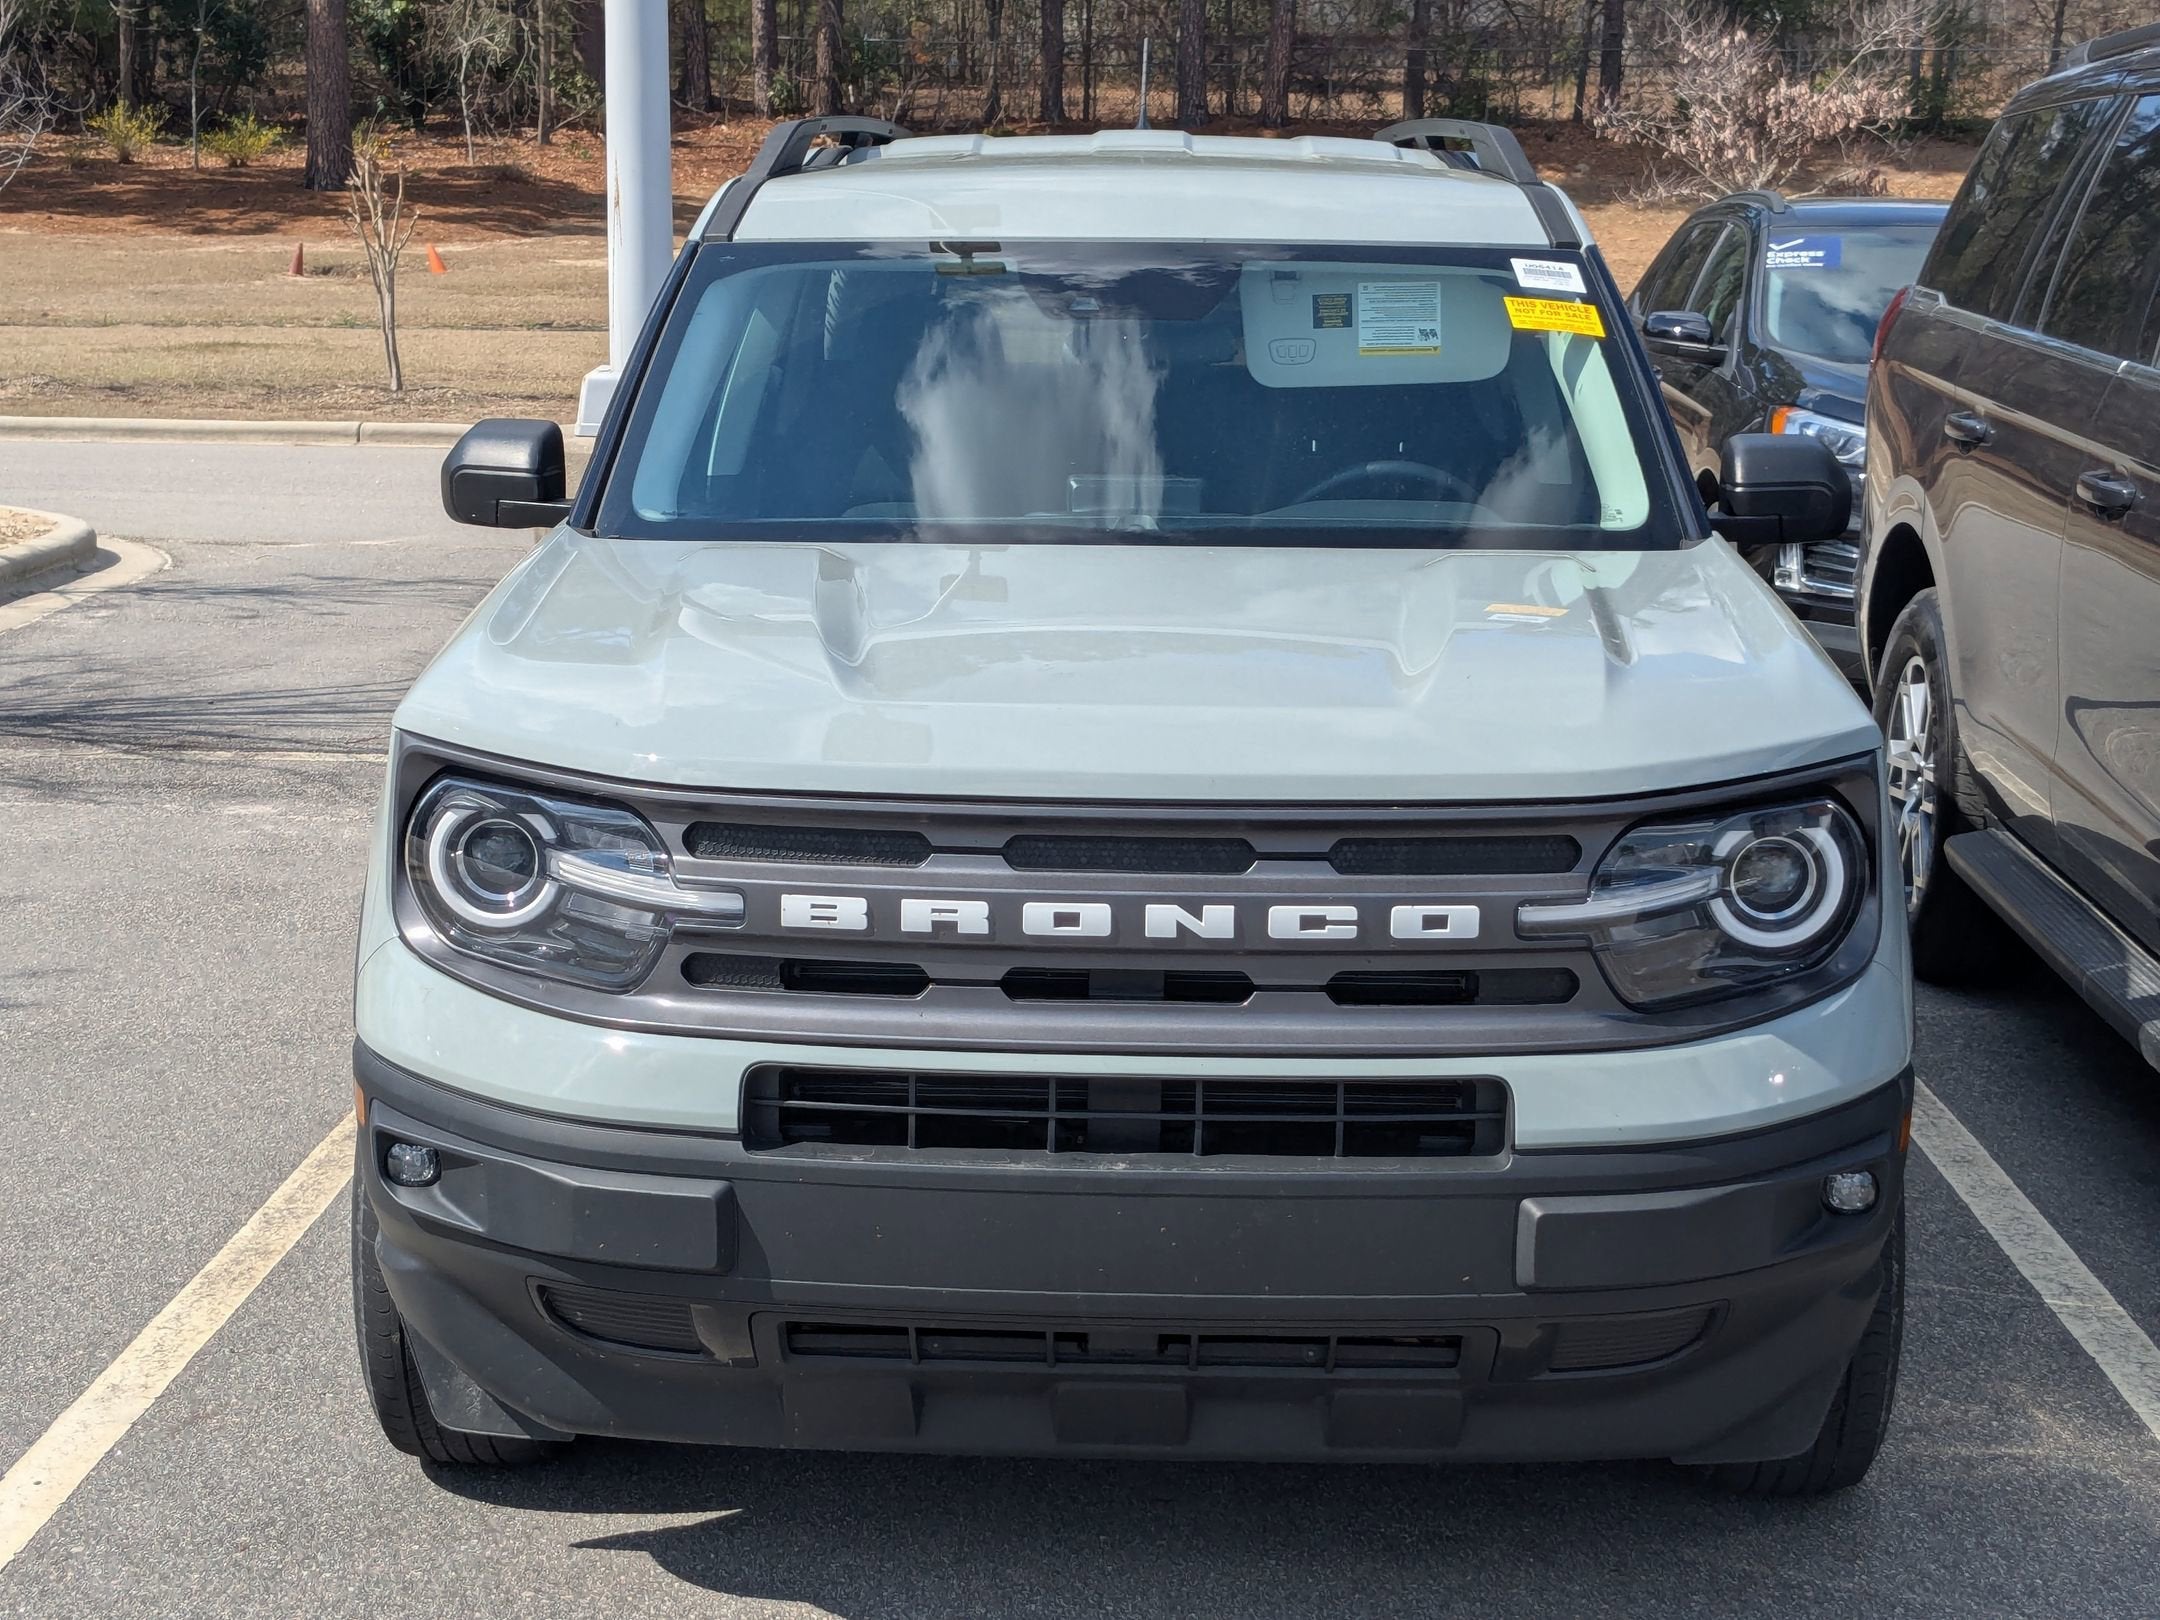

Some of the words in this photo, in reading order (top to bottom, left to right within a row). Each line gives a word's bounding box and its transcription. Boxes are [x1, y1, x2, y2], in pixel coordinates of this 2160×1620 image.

[1510, 300, 1537, 308] THIS
[1540, 303, 1592, 314] VEHICLE
[781, 894, 1480, 940] BRONCO
